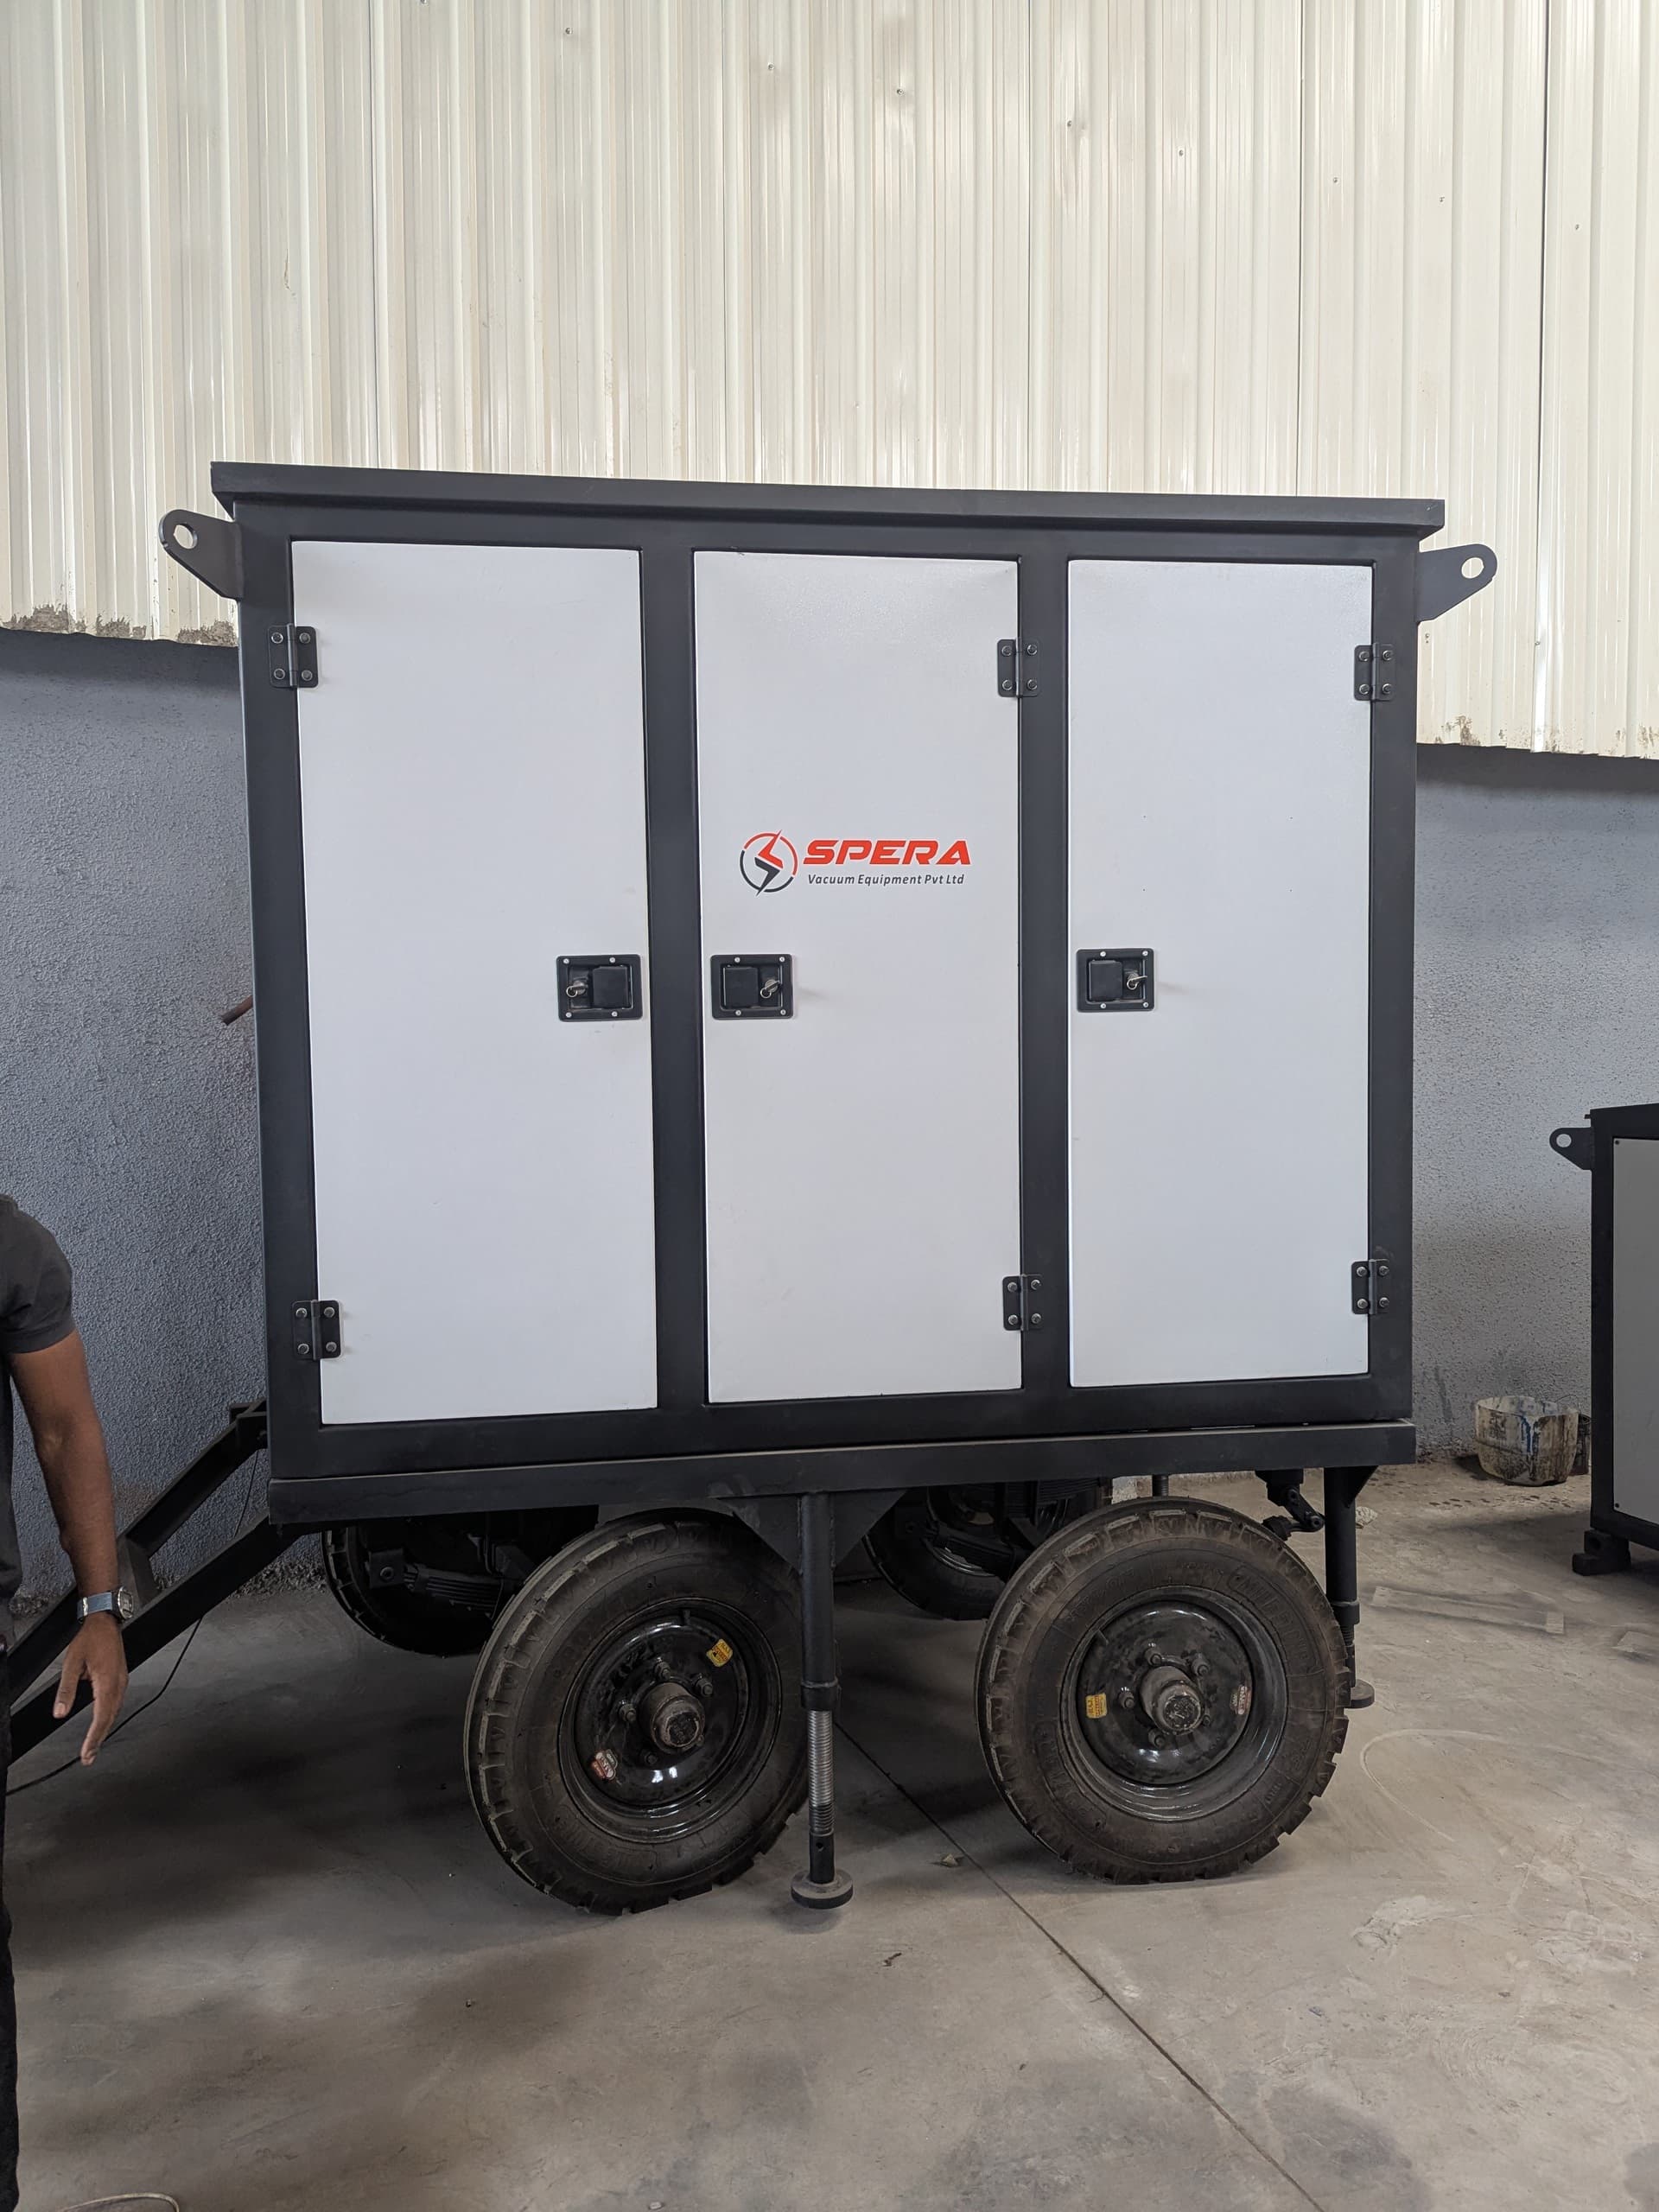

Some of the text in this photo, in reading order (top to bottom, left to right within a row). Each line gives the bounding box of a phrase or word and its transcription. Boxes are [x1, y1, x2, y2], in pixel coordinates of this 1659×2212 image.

[803, 840, 971, 865] SPERA
[808, 874, 964, 887] Vacuum Equipment Pvt Ltd
